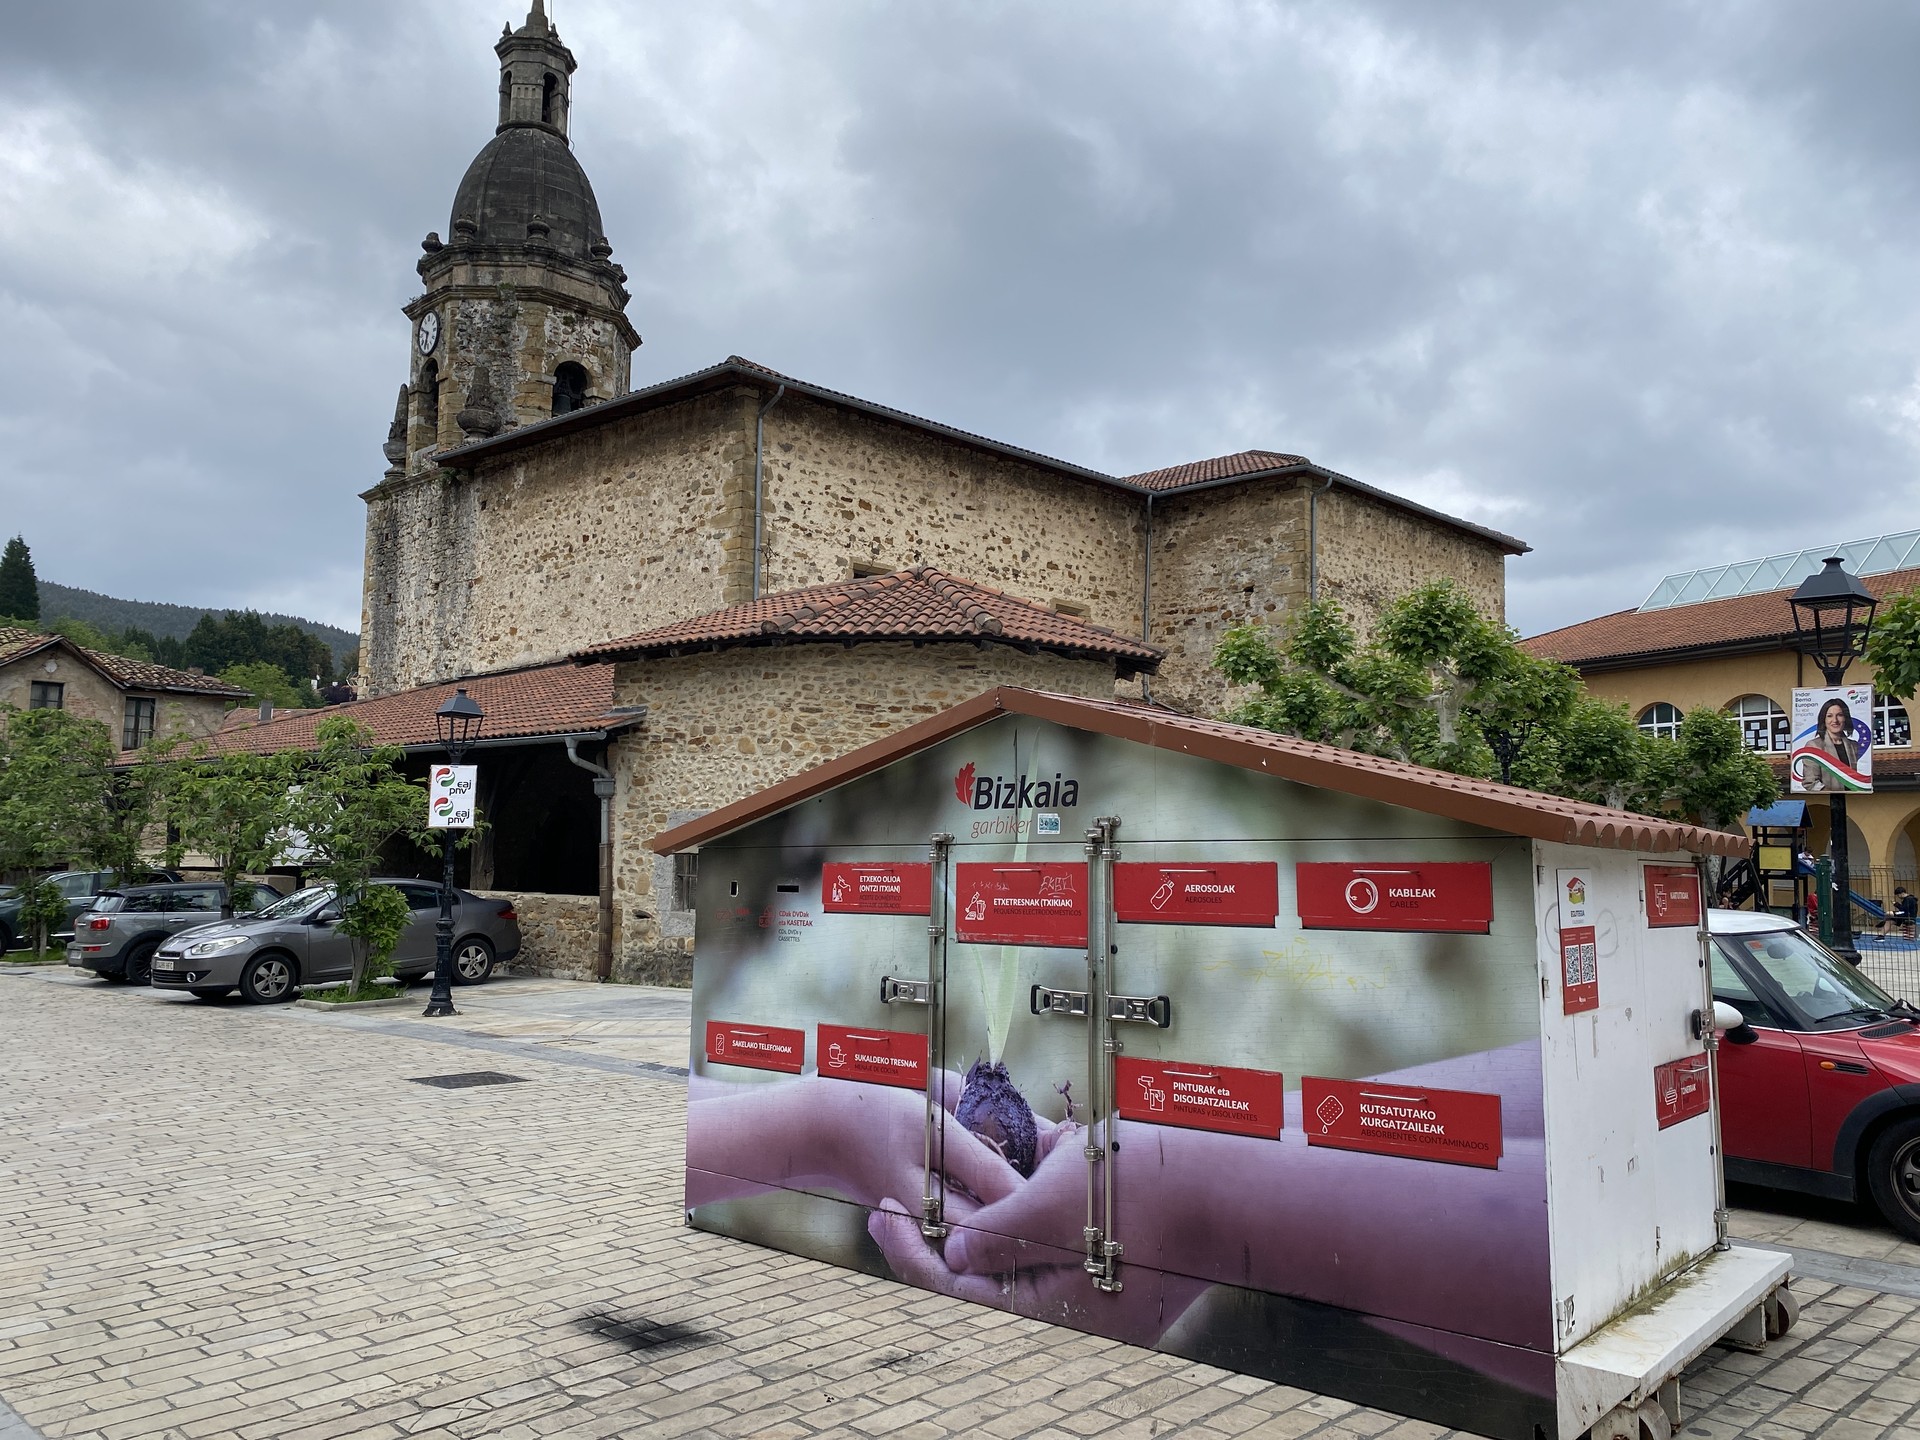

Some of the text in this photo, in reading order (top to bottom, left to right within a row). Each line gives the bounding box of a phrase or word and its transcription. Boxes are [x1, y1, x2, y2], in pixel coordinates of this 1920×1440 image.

[457, 780, 472, 790] eaj
[449, 788, 467, 796] pnv
[974, 773, 1079, 810] Bizkaia
[455, 809, 470, 819] eaj
[447, 817, 466, 825] pnv
[971, 816, 1032, 839] garbiker
[859, 875, 881, 883] ETXEKO
[879, 885, 901, 893] ITXIAN)
[1184, 884, 1236, 894] AEROSOLAK
[1389, 888, 1436, 898] KABLEAK
[993, 898, 1073, 908] ETXETRESNAK (TXIKIAK)
[1184, 896, 1223, 904] AEROSOLES
[1389, 900, 1419, 908] CABLES
[732, 1039, 792, 1054] SAKELAKO TELEFONOAK
[854, 1053, 918, 1069] SUKALDEKO TRESNAK
[1173, 1081, 1230, 1096] PINTURAK eta
[1173, 1093, 1249, 1111] DISOLBATZAILEAK
[1173, 1104, 1206, 1116] PINTURAS
[1211, 1109, 1258, 1122] DISOLVENTES
[1359, 1103, 1436, 1121] KUTSATUTAKO
[1360, 1116, 1445, 1135] XURGATZAILEAK
[1360, 1128, 1490, 1151] ABSORBENTES CONTAMINADOS
